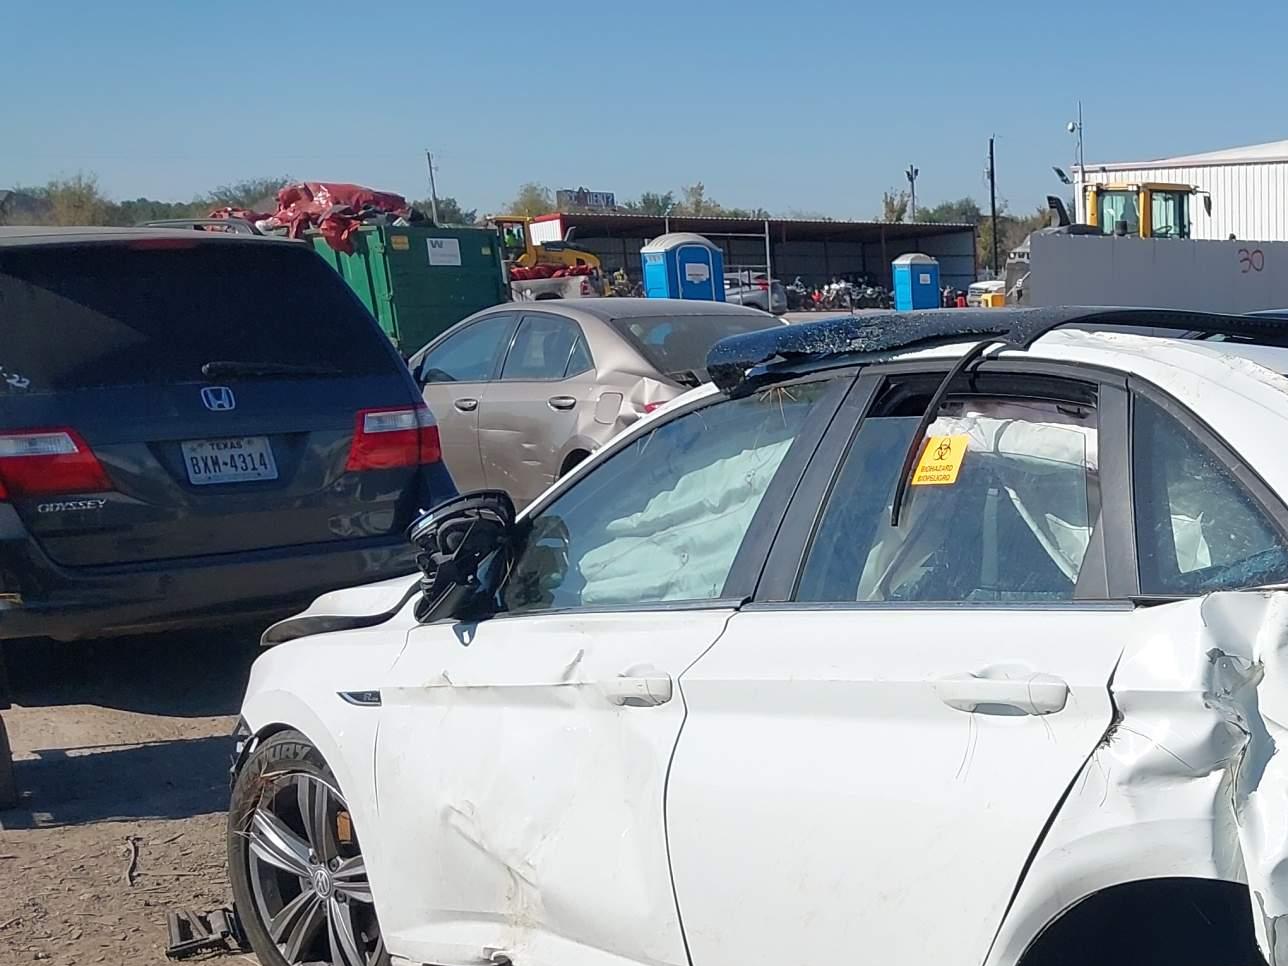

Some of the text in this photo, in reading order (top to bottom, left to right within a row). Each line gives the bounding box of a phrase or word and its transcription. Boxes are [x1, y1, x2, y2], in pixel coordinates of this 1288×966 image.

[1238, 248, 1265, 273] 30
[208, 441, 243, 451] TEXAS
[37, 499, 107, 513] ODYSSEY
